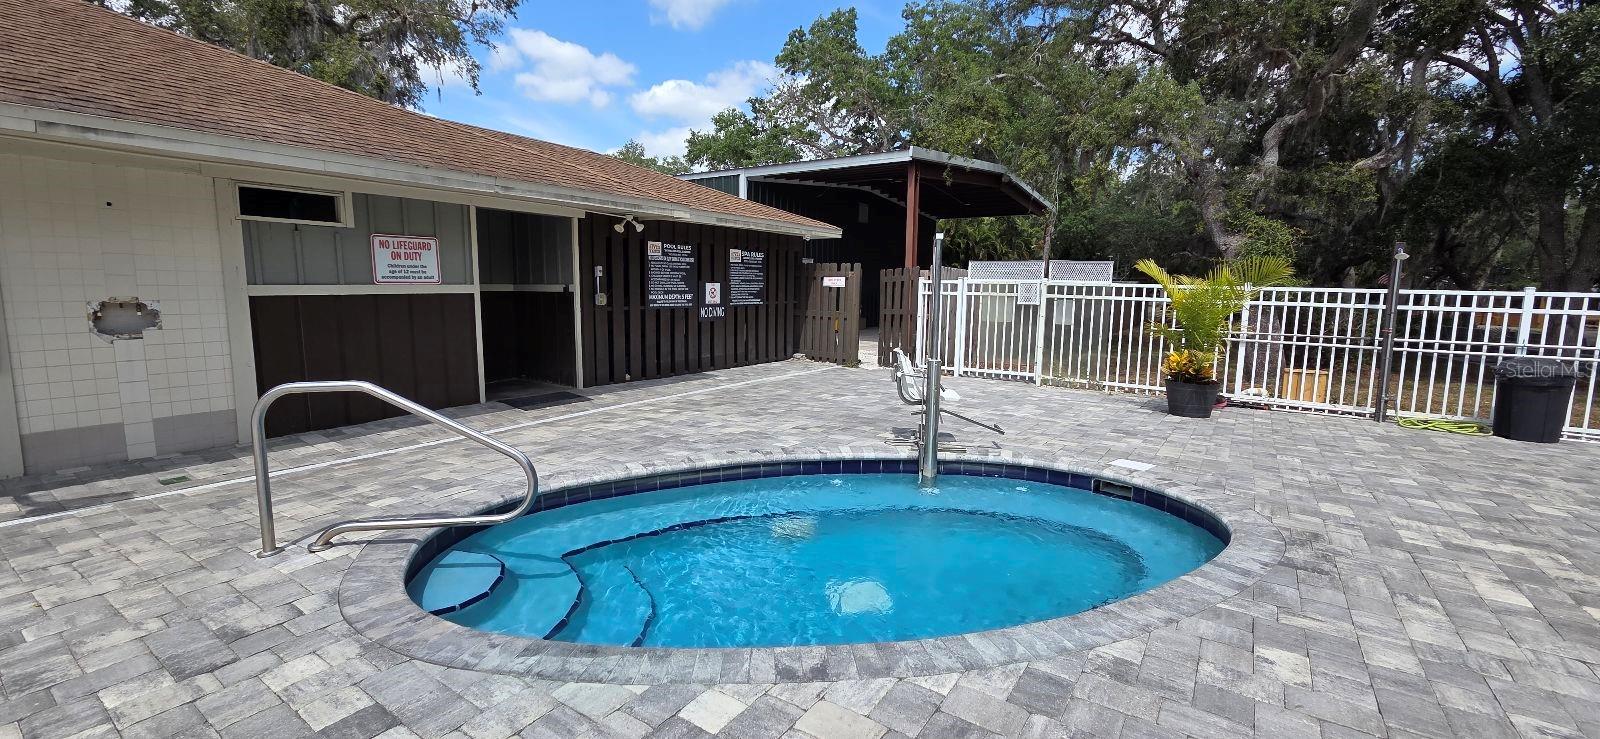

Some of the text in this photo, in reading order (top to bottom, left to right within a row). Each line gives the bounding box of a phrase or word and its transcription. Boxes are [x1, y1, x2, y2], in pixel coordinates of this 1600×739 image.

[379, 240, 431, 251] NO LIFEGUARD
[390, 251, 422, 261] ON DUTY
[700, 306, 724, 317] NO DIVING
